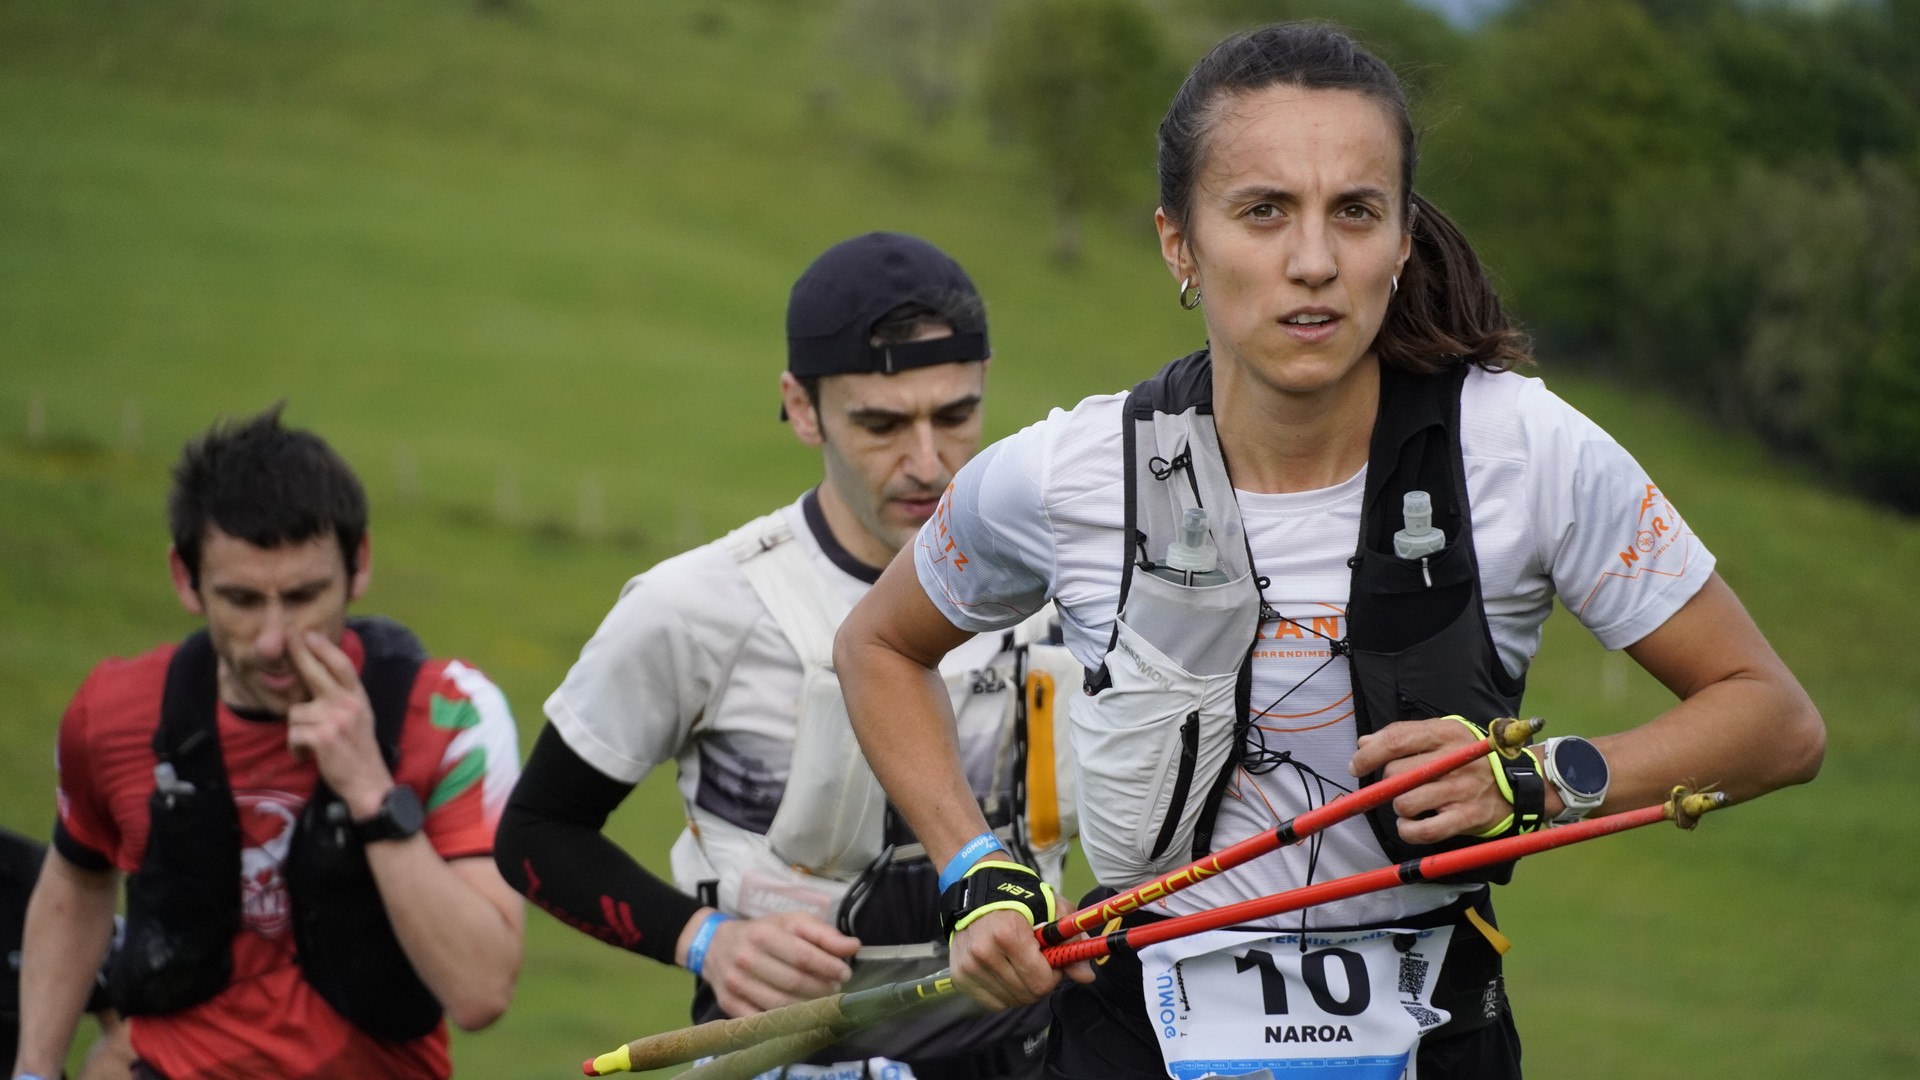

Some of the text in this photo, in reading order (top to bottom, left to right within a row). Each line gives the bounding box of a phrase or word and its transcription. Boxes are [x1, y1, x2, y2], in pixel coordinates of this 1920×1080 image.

[997, 882, 1035, 899] LEKI
[1234, 947, 1371, 1016] 10
[1156, 971, 1176, 1039] DOMU
[1264, 1025, 1353, 1043] NAROA
